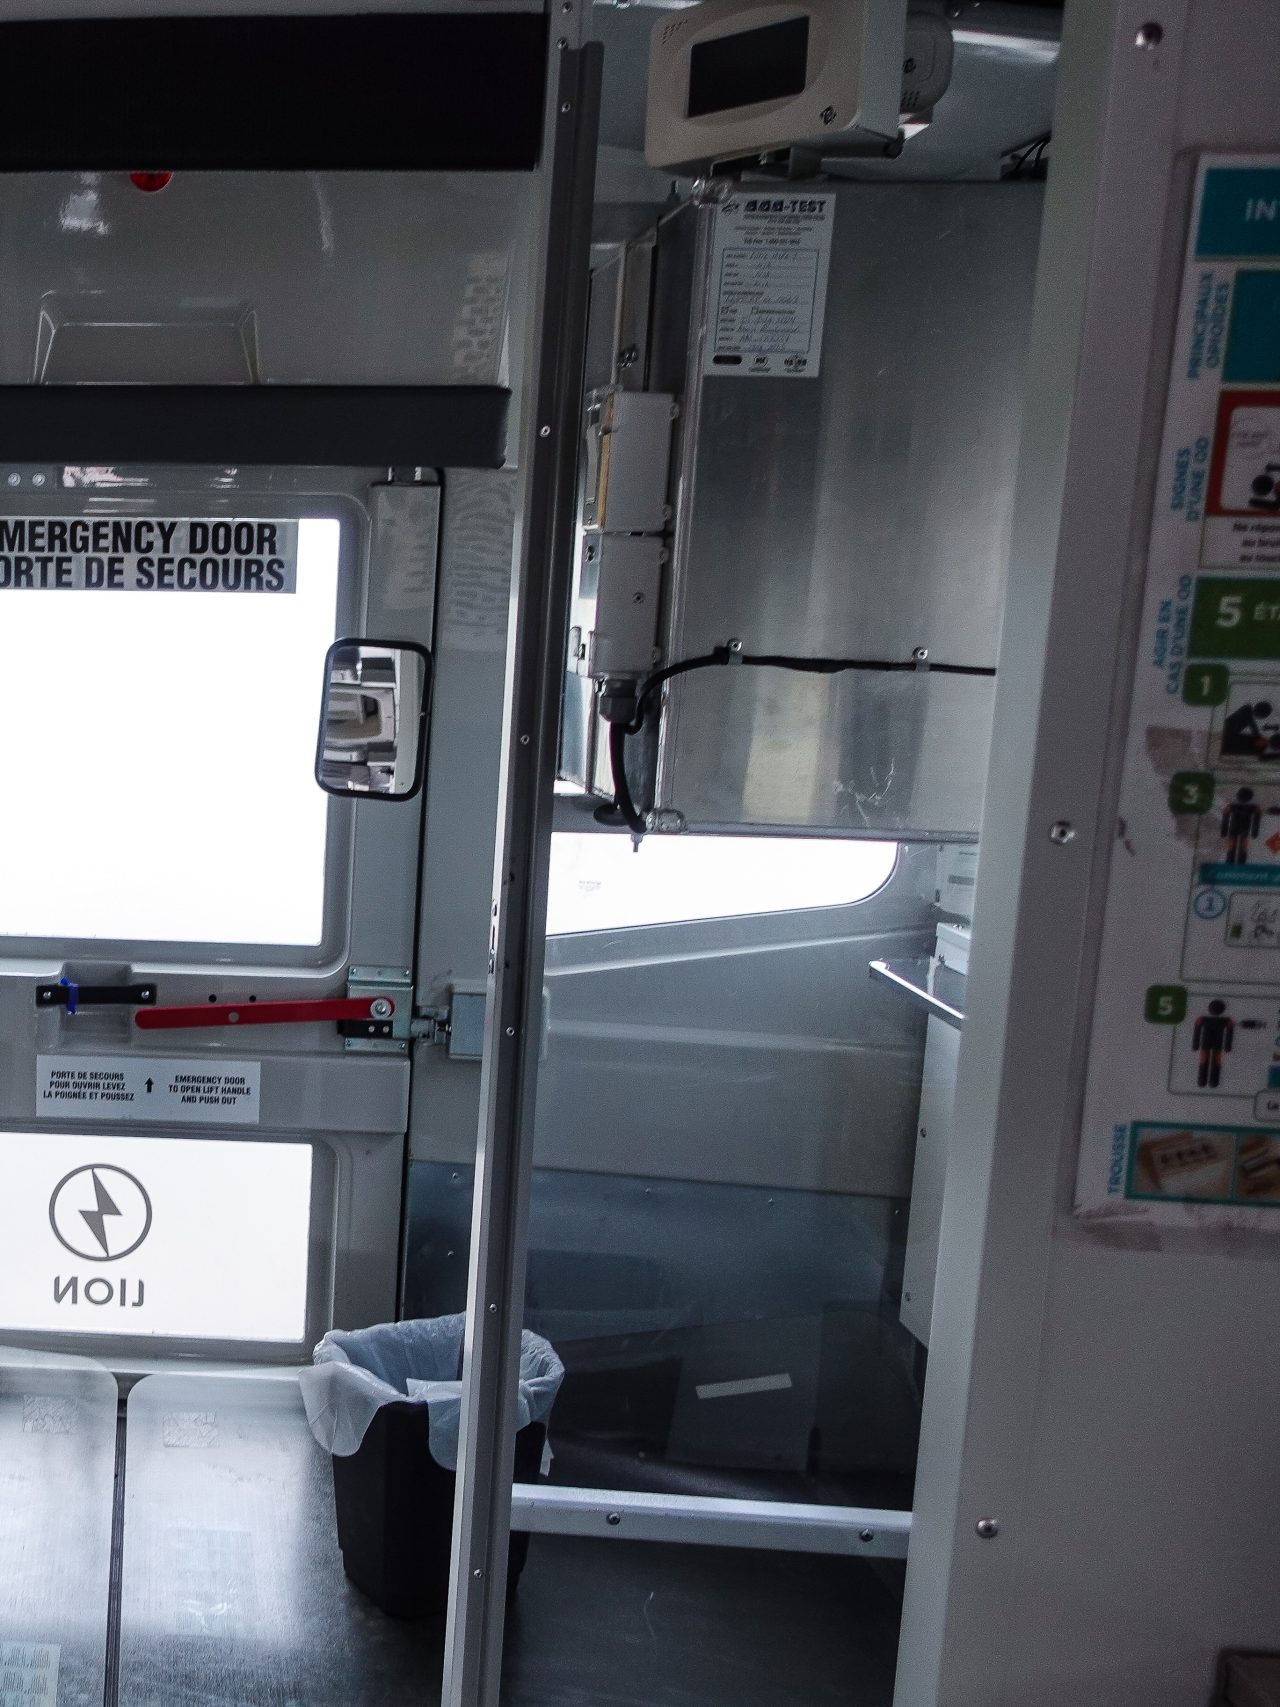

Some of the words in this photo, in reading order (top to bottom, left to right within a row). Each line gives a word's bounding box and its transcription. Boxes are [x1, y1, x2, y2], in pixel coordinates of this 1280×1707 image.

[1245, 198, 1280, 221] IN
[1186, 271, 1213, 379] PRINCIPAUX
[1193, 436, 1210, 464] OD
[1170, 447, 1191, 511] SIGNES
[189, 522, 277, 555] DOOR
[85, 557, 125, 589] DE
[136, 557, 285, 591] SECOURS
[1158, 598, 1173, 623] EN
[1215, 596, 1242, 627] 5
[1253, 601, 1280, 621] ÉT
[1166, 661, 1181, 695] CAS
[1177, 574, 1192, 601] OD
[1200, 674, 1211, 696] 1
[1181, 783, 1199, 805] 3
[1157, 995, 1175, 1016] 5
[49, 1080, 70, 1089] POUR
[72, 1081, 100, 1090] OUVRIR
[102, 1082, 126, 1091] LEVEZ
[50, 1070, 76, 1079] PORTE
[78, 1071, 87, 1080] DE
[89, 1072, 124, 1081] SECOURS
[174, 1075, 222, 1084] EMERGENCY
[224, 1076, 246, 1085] DOOR
[43, 1090, 52, 1099] LA
[54, 1089, 87, 1100] POIGNÉE
[89, 1092, 99, 1100] ET
[101, 1092, 135, 1101] POUSSEZ
[168, 1085, 178, 1093] TO
[180, 1085, 201, 1094] OPEN
[202, 1086, 219, 1094] LIFT
[221, 1086, 251, 1096] HANDLE
[181, 1095, 197, 1104] AND
[198, 1095, 219, 1105] PUSH
[221, 1096, 237, 1105] OUT
[1107, 1123, 1127, 1193] TROUSSE
